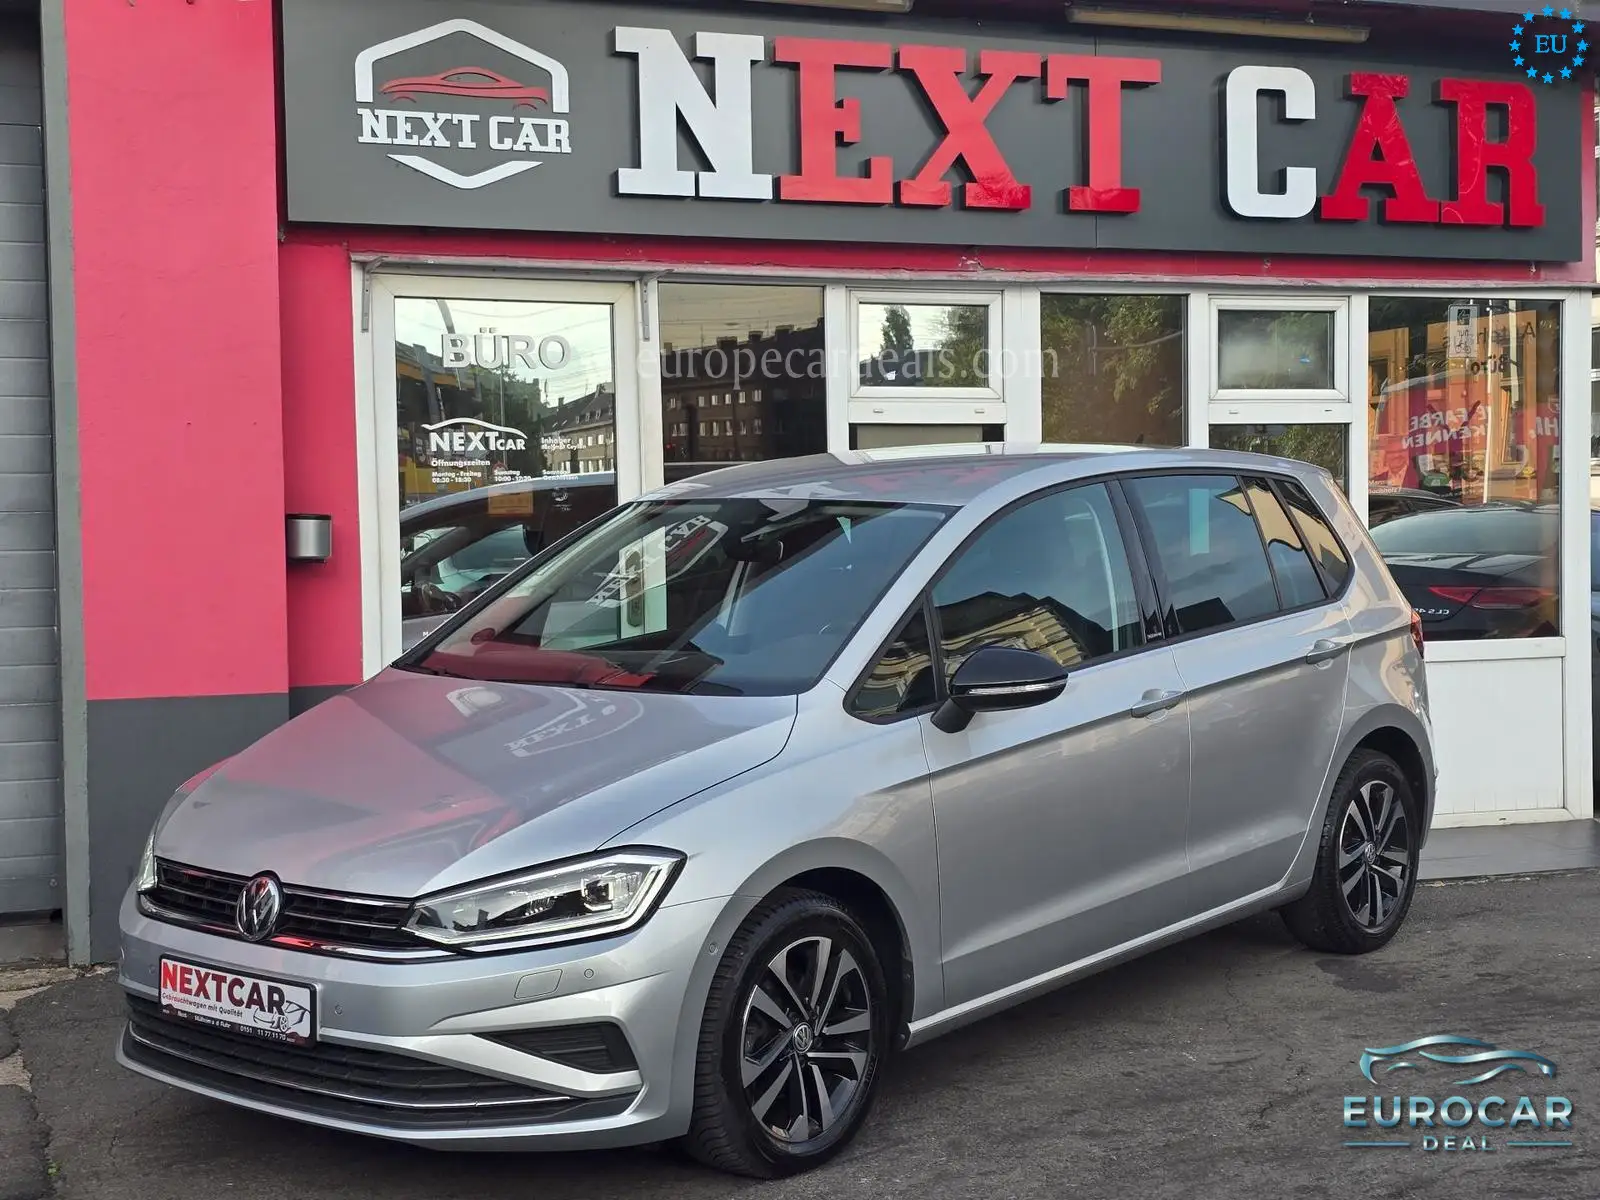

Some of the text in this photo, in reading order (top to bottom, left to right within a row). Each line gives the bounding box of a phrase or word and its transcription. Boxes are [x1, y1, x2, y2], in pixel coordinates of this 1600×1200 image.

[357, 108, 572, 154] NEXT CAR
[612, 26, 1545, 227] NEXT CAR
[441, 327, 572, 370] BÜRO
[541, 436, 571, 445] Inhaber
[431, 458, 491, 468] Öffnungszeiten
[162, 961, 286, 1016] NEXTCAR
[162, 992, 243, 1018] Gebrauchtwagen mit Qualität
